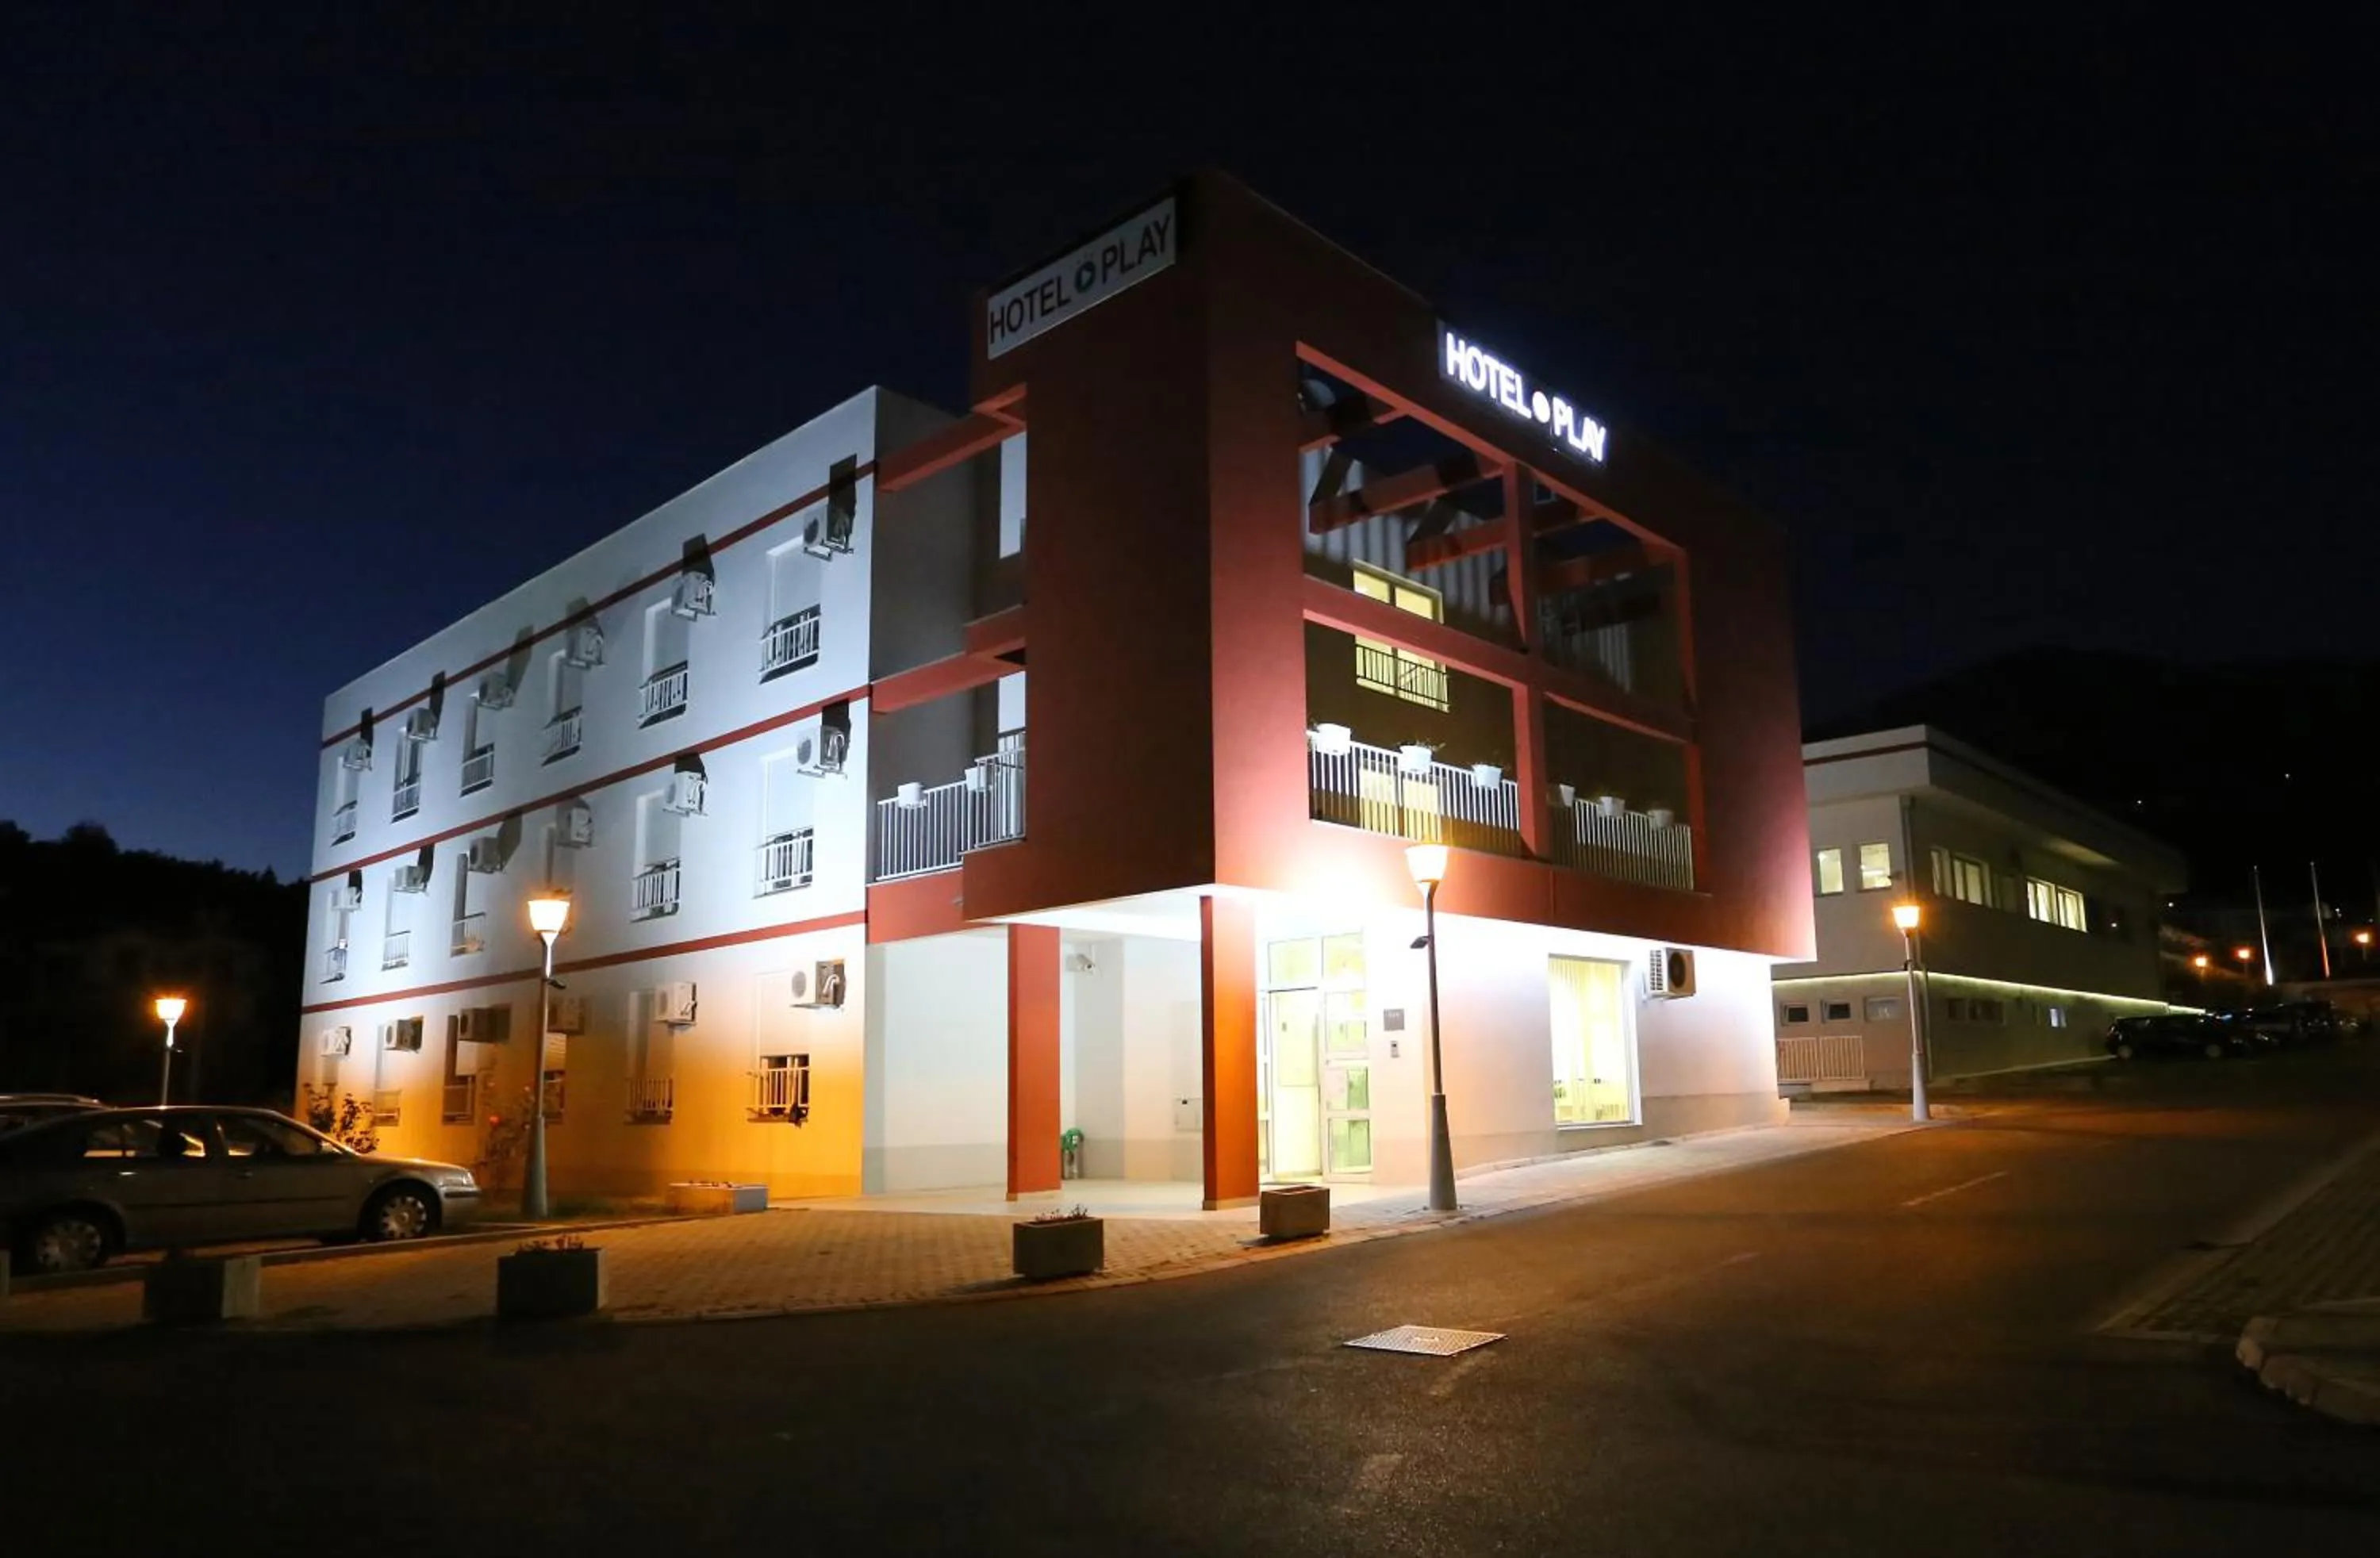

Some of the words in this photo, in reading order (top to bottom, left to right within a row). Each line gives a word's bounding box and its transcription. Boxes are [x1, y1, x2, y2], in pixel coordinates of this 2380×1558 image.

[989, 276, 1071, 344] HOTEL
[1102, 213, 1170, 284] PLAY
[1446, 332, 1532, 420] HOTEL
[1553, 397, 1606, 462] PLAY
